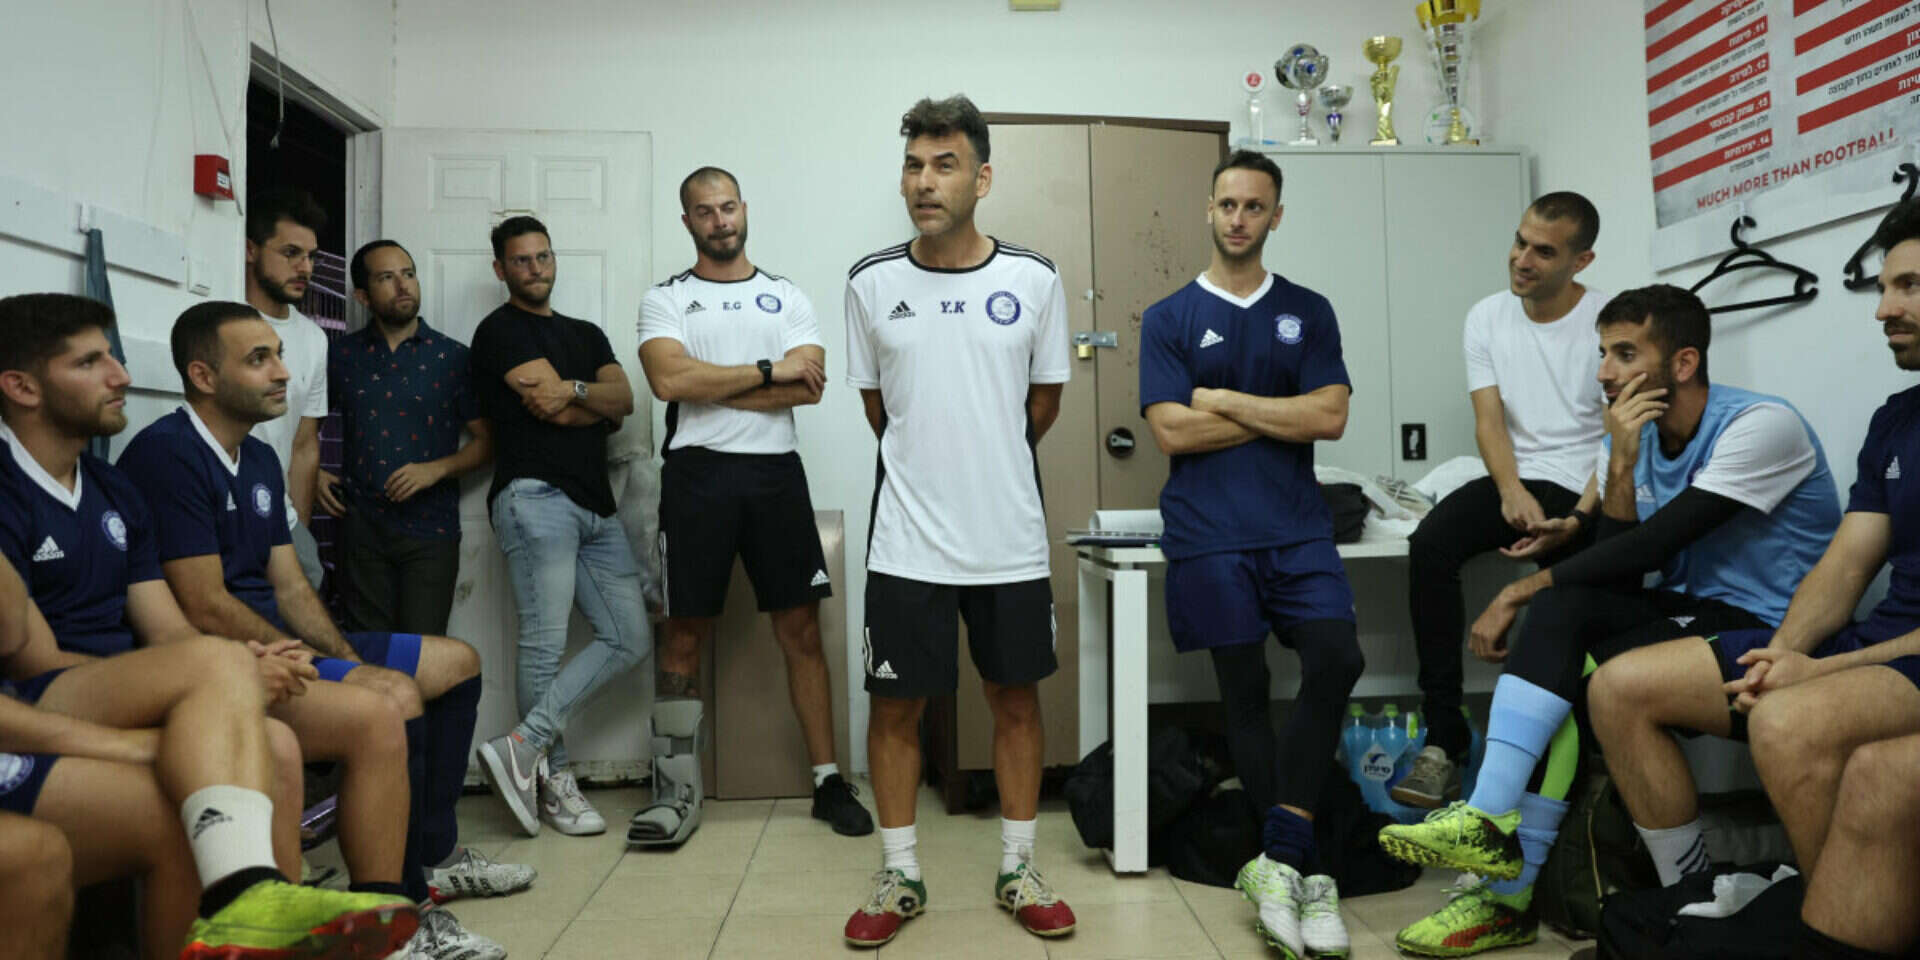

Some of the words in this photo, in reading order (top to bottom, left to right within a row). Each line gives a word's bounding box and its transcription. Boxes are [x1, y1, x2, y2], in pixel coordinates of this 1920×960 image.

[1697, 187, 1730, 209] MUCH
[1733, 173, 1769, 198] MORE
[1772, 158, 1810, 184] THAN
[722, 301, 742, 311] E.G
[940, 301, 966, 314] Y.K
